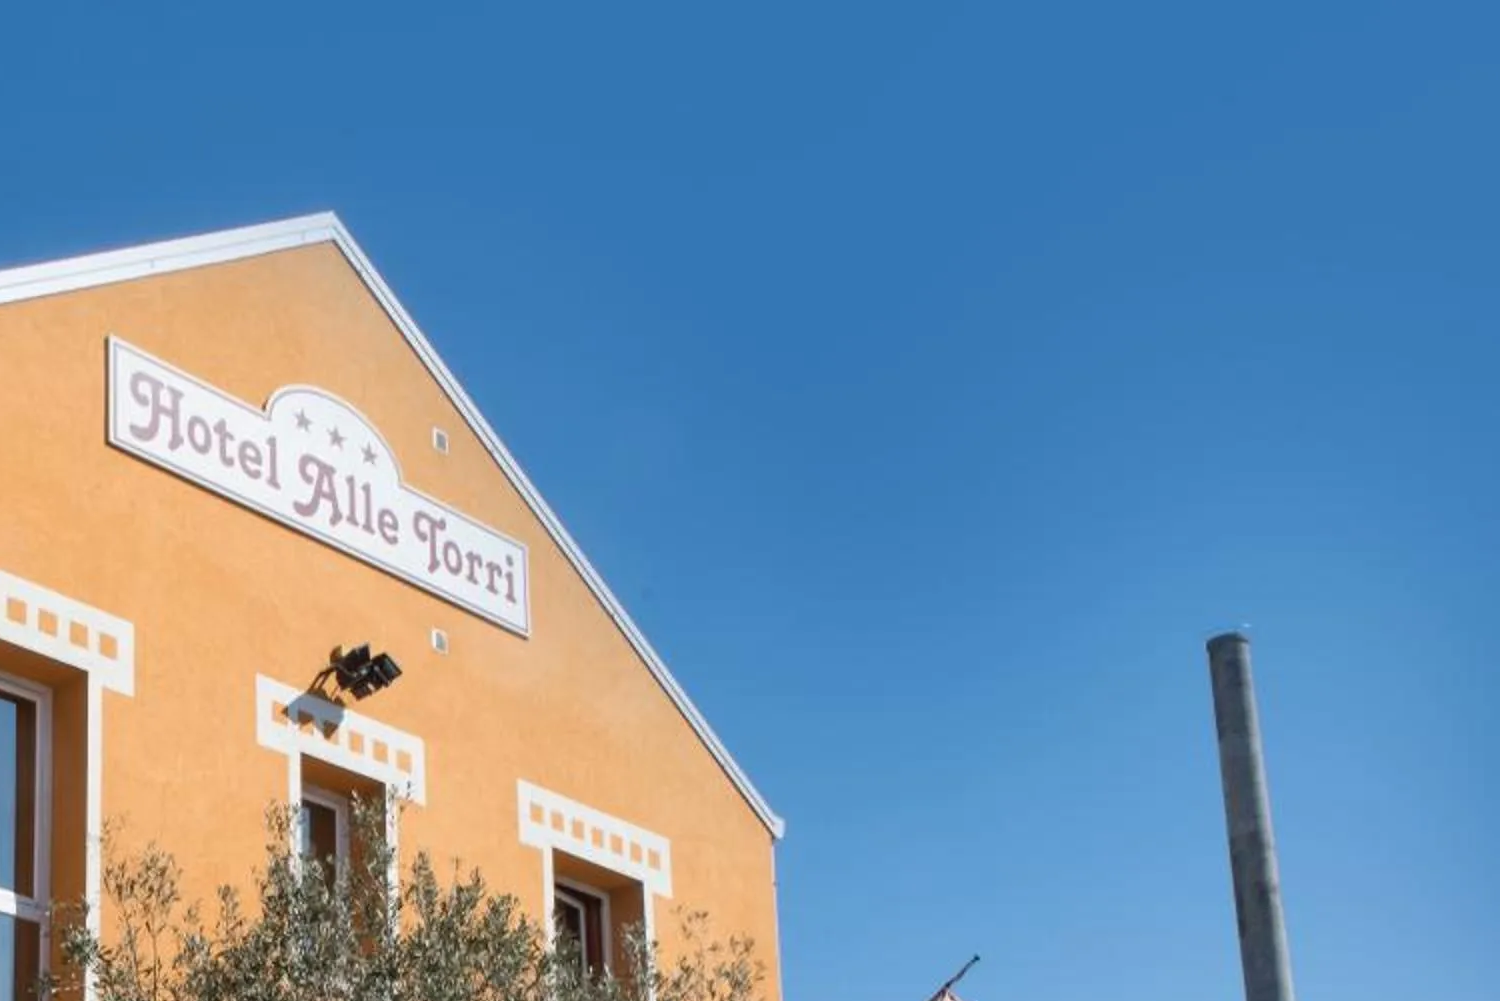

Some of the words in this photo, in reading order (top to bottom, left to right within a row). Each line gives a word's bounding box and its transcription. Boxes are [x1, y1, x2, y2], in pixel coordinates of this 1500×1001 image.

[129, 370, 282, 491] Hotel
[292, 453, 400, 546] Alle
[412, 508, 518, 605] Torri
